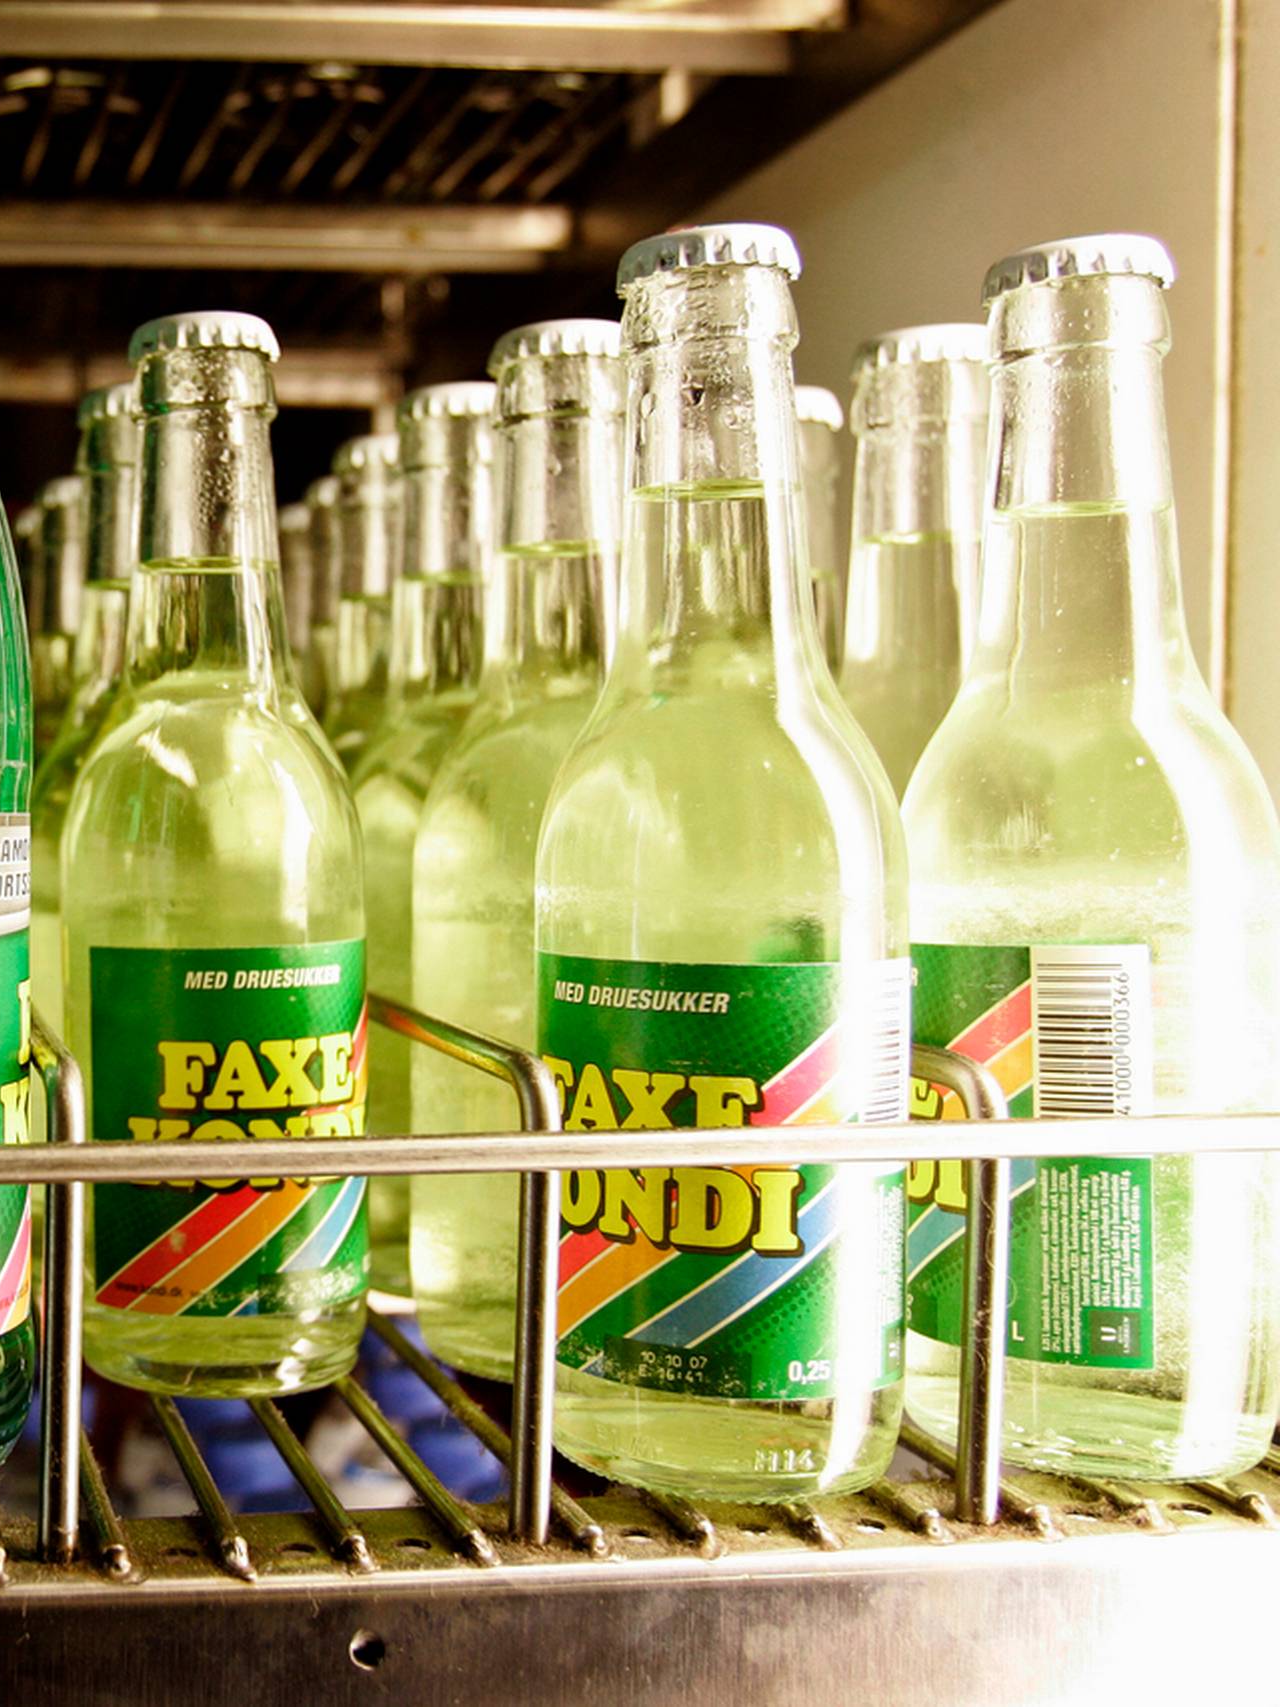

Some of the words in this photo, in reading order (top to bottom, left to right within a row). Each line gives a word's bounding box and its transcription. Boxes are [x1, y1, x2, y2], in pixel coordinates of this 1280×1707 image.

[184, 971, 228, 989] MED
[233, 963, 341, 989] DRUESUKKER
[554, 980, 584, 1003] MED
[588, 985, 730, 1014] DRUESUKKER
[157, 1032, 353, 1110] FAXE
[560, 1166, 801, 1251] ONDI
[689, 1355, 708, 1369] 07
[787, 1360, 832, 1385] 0,25
